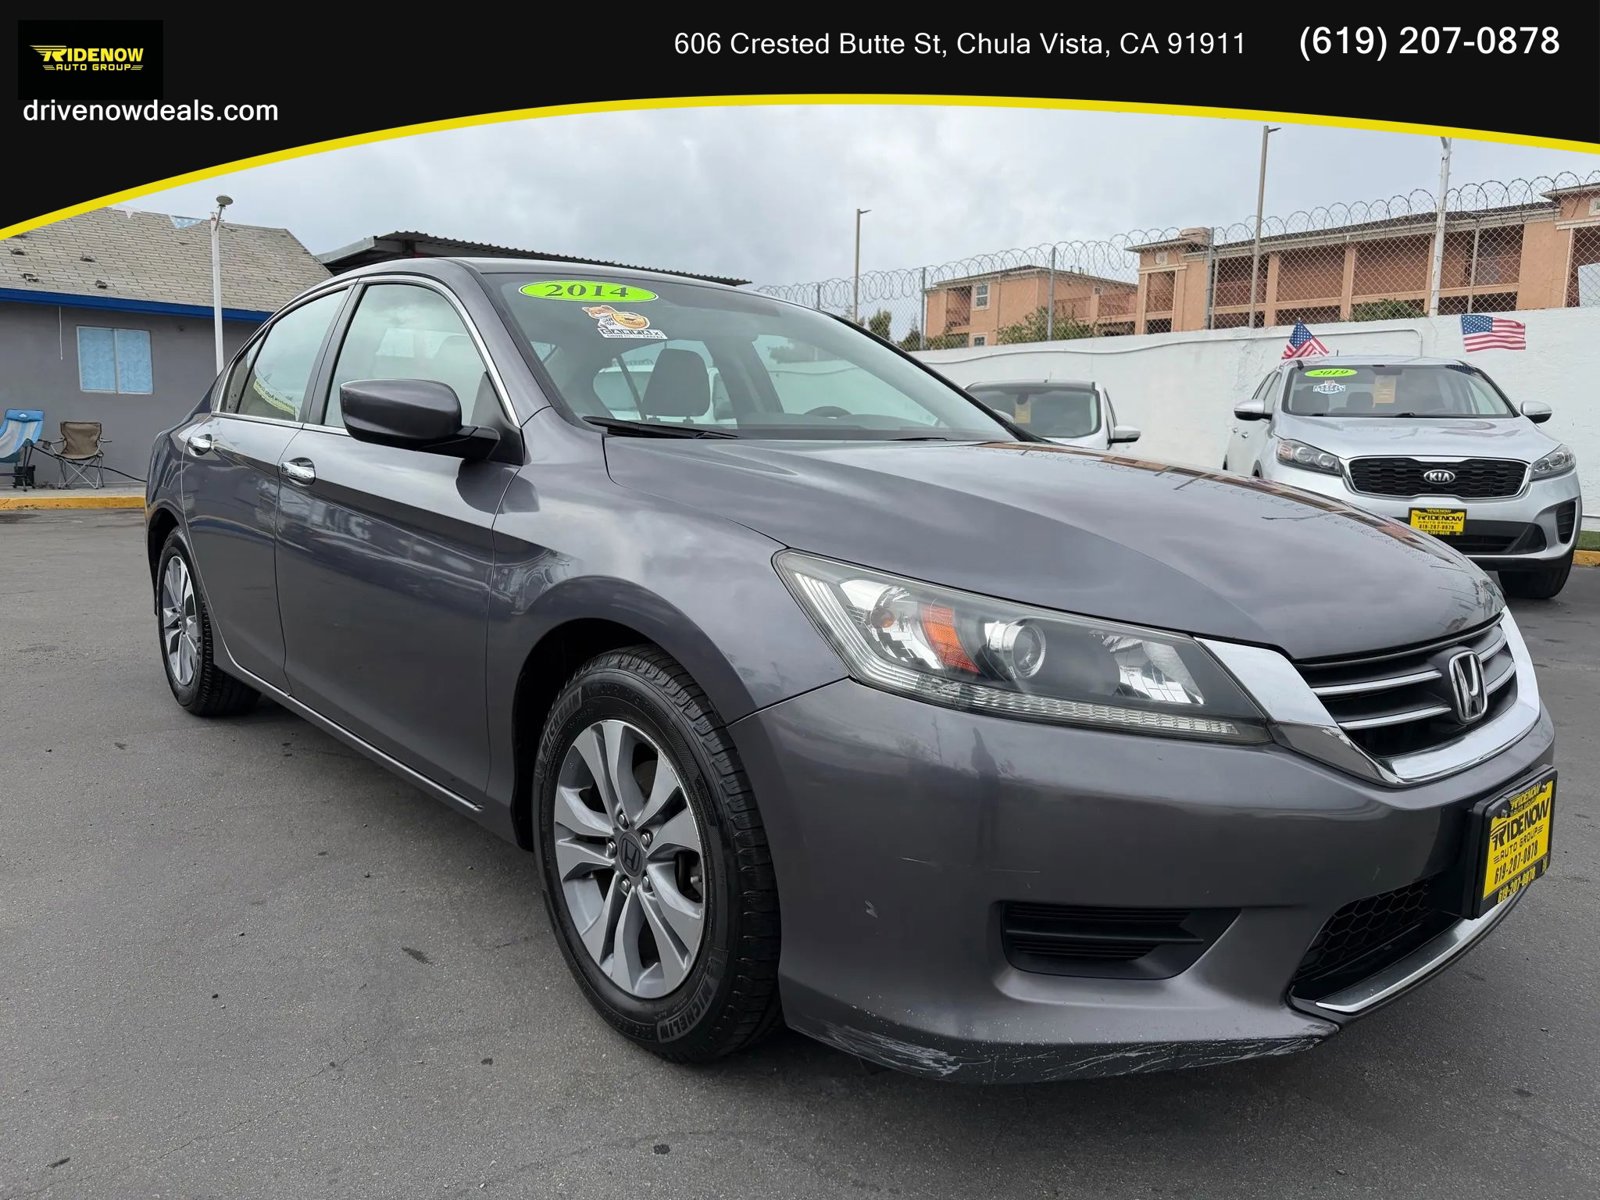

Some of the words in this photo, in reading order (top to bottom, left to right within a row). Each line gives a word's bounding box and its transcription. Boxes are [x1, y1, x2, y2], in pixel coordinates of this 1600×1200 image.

[545, 284, 629, 298] 2014
[1429, 472, 1450, 481] KIA
[1490, 797, 1551, 852] RIDENOW
[1500, 842, 1518, 862] AUTO
[1520, 829, 1538, 848] GROUP
[1494, 840, 1538, 885] 619-207-0878
